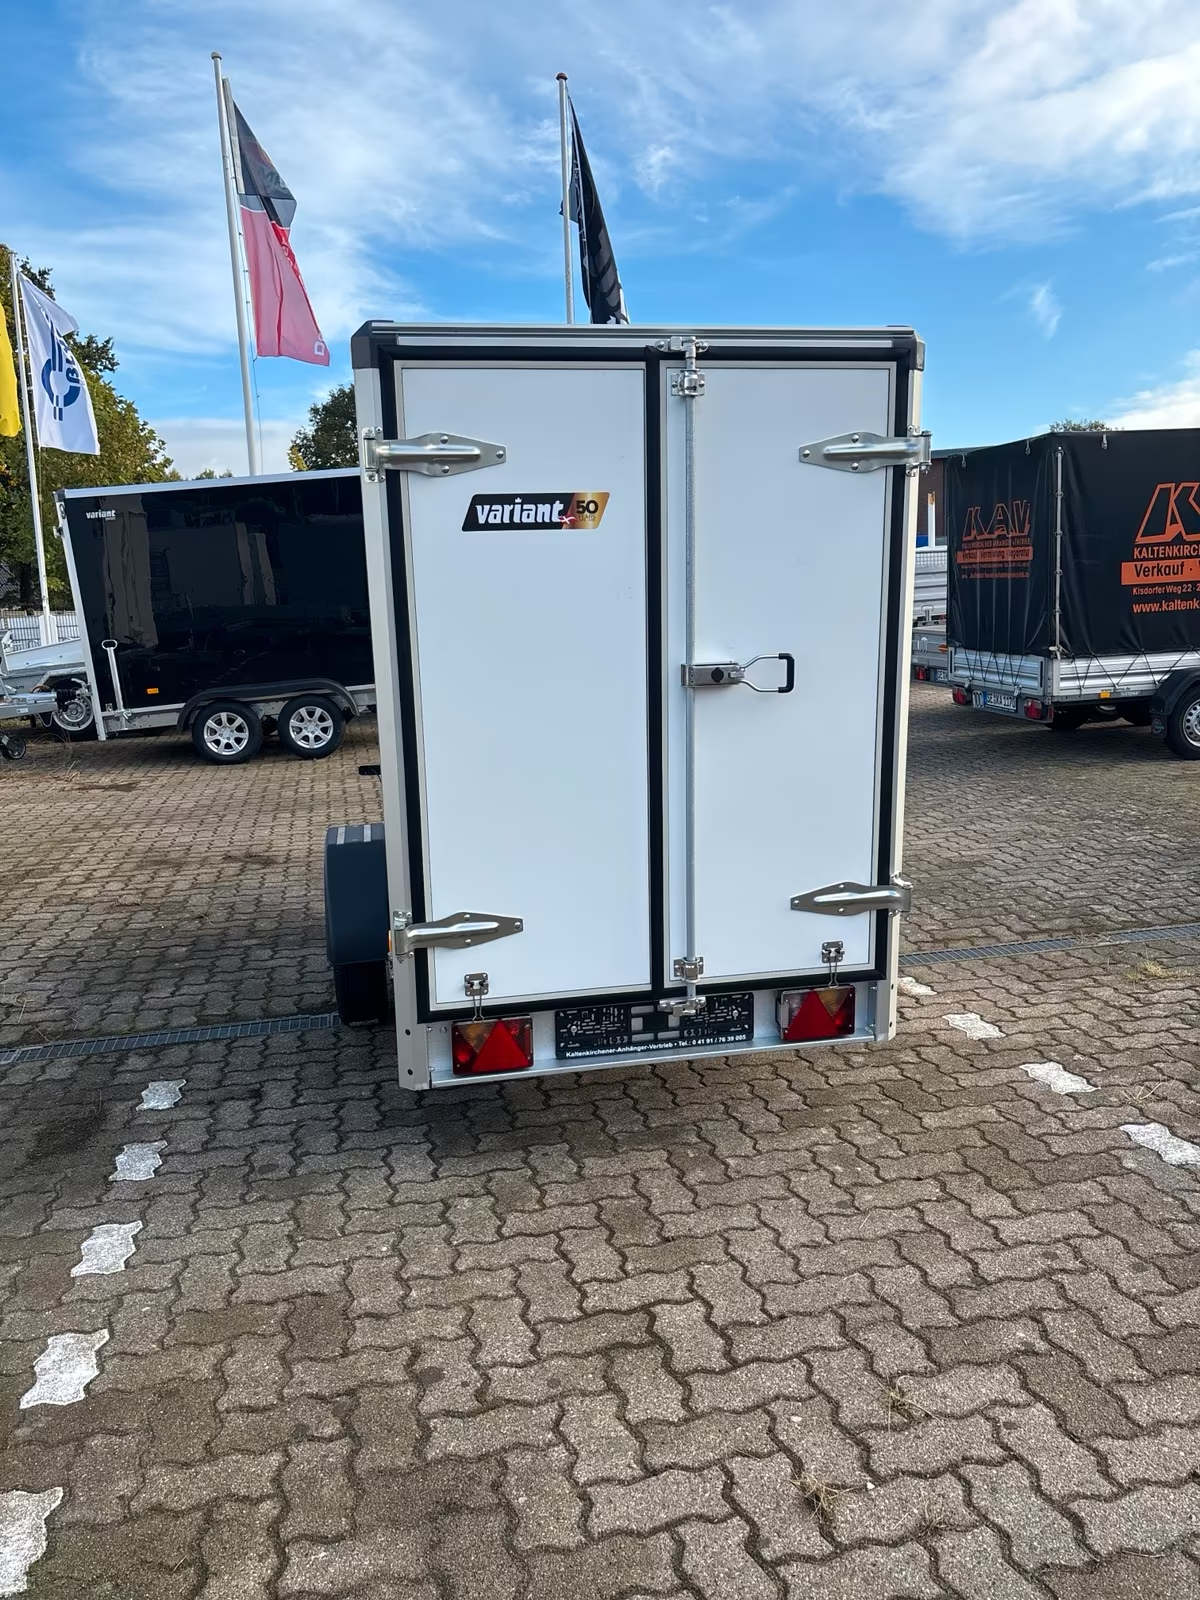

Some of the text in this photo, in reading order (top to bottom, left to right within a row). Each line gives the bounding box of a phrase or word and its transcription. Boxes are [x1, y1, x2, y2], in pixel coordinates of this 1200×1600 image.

[85, 509, 116, 519] variant
[475, 497, 599, 524] variant 50
[1133, 544, 1200, 559] KALTENKIRC
[1133, 561, 1185, 578] Verkauf
[1132, 586, 1165, 596] Kisdorfer
[1165, 585, 1181, 595] Weg
[1182, 584, 1192, 592] 22
[566, 1041, 673, 1058] Kaltenkirchener-Anhänger-Vertrieb
